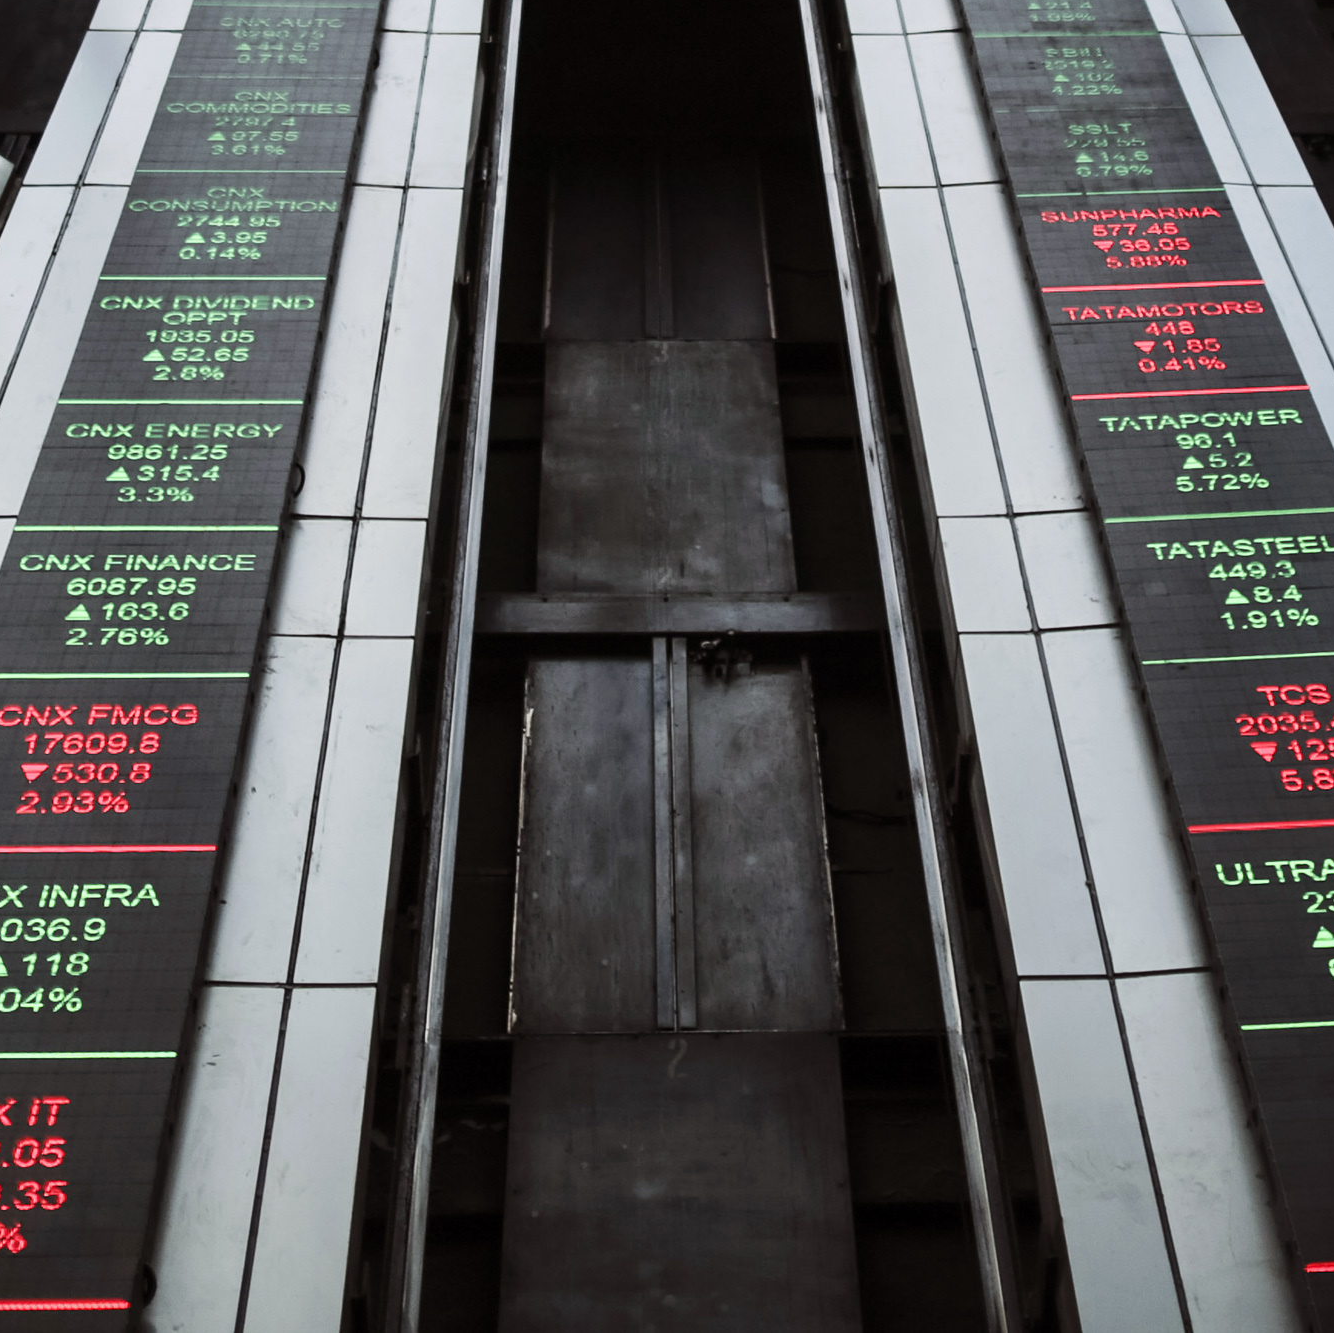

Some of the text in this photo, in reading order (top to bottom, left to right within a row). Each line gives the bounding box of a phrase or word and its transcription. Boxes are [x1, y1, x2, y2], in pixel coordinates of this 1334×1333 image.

[221, 18, 346, 29] CNX AUTO
[256, 42, 320, 51] 44.55
[237, 54, 308, 64] 0.71%
[1076, 73, 1115, 81] 102
[235, 92, 288, 101] CNX
[1052, 85, 1123, 96] 4.22%
[168, 103, 350, 113] COMMODITIES
[215, 117, 297, 127] 2797.4
[1068, 123, 1134, 134] SSLT
[232, 131, 298, 141] 97.55
[212, 145, 285, 155] 3.61%
[1076, 165, 1153, 177] 6.79%
[208, 188, 264, 198] CNX
[130, 199, 337, 211] CONSUMPTION
[178, 216, 280, 226] 2744.95
[1041, 207, 1220, 222] SUNPHARMA
[1093, 223, 1178, 236] 577.45
[211, 232, 267, 243] 3.95
[1120, 238, 1190, 251] 36.05
[180, 247, 261, 259] 0.14%
[1106, 254, 1189, 269] 5.88%
[101, 296, 314, 309] CNX DIVIDEND
[1062, 301, 1264, 320] TATAMOTORS
[163, 311, 247, 325] OPPT
[1146, 322, 1194, 335] 448
[147, 330, 254, 342] 1935.05
[1163, 338, 1220, 353] 1.85
[172, 348, 248, 361] 52.65
[1138, 357, 1226, 373] 0.41%
[153, 366, 224, 380] 2.8%
[1099, 409, 1302, 432] TATAPOWER
[66, 424, 282, 438] CNX ENERGY
[1176, 433, 1235, 449] 96.1
[108, 444, 228, 460] 9861.25
[1209, 453, 1252, 467] 5.2
[137, 465, 219, 481] 315.4
[1176, 473, 1269, 492] 5.72%
[118, 487, 194, 502] 3.3%
[20, 555, 256, 570] CNX FINANCE
[1209, 561, 1295, 580] 449.3
[67, 578, 196, 595] 6087.95
[1254, 585, 1302, 603] 8.4
[102, 602, 189, 620] 163.6
[1221, 608, 1319, 629] 1.91%
[66, 628, 169, 645] 2.76%
[1256, 684, 1330, 706] TCS
[87, 704, 198, 725] FMCG
[25, 732, 160, 754] 17609.8
[52, 763, 151, 783] 530.8
[16, 791, 129, 814] 2.93%
[39, 884, 159, 907] INFRA
[23, 952, 89, 976] 118
[28, 1097, 70, 1126] IT
